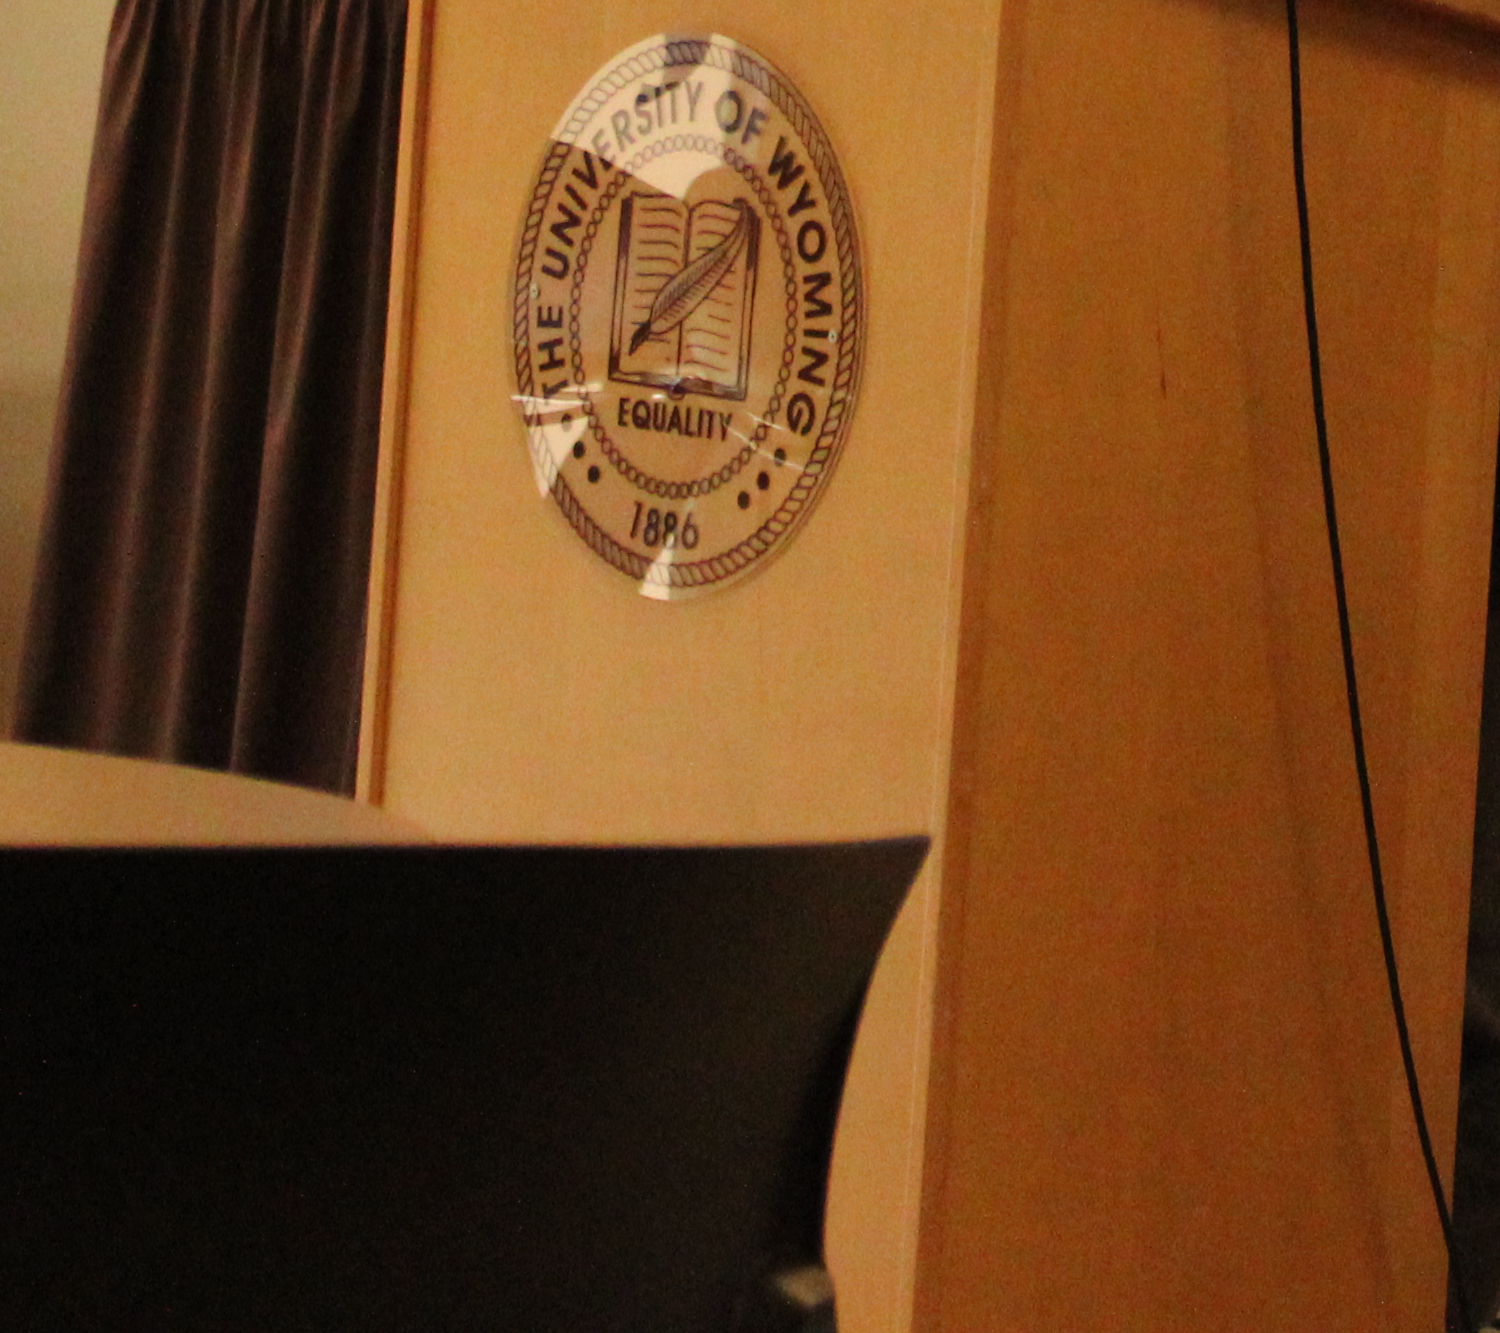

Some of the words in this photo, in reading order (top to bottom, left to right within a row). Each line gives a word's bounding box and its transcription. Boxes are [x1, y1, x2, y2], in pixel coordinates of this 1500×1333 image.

[714, 90, 769, 145] OF
[542, 80, 706, 280] UNIVERSITY
[768, 135, 833, 436] WYOMING
[537, 305, 569, 401] THE
[617, 397, 732, 442] EQUALITY
[629, 501, 699, 550] 1886
